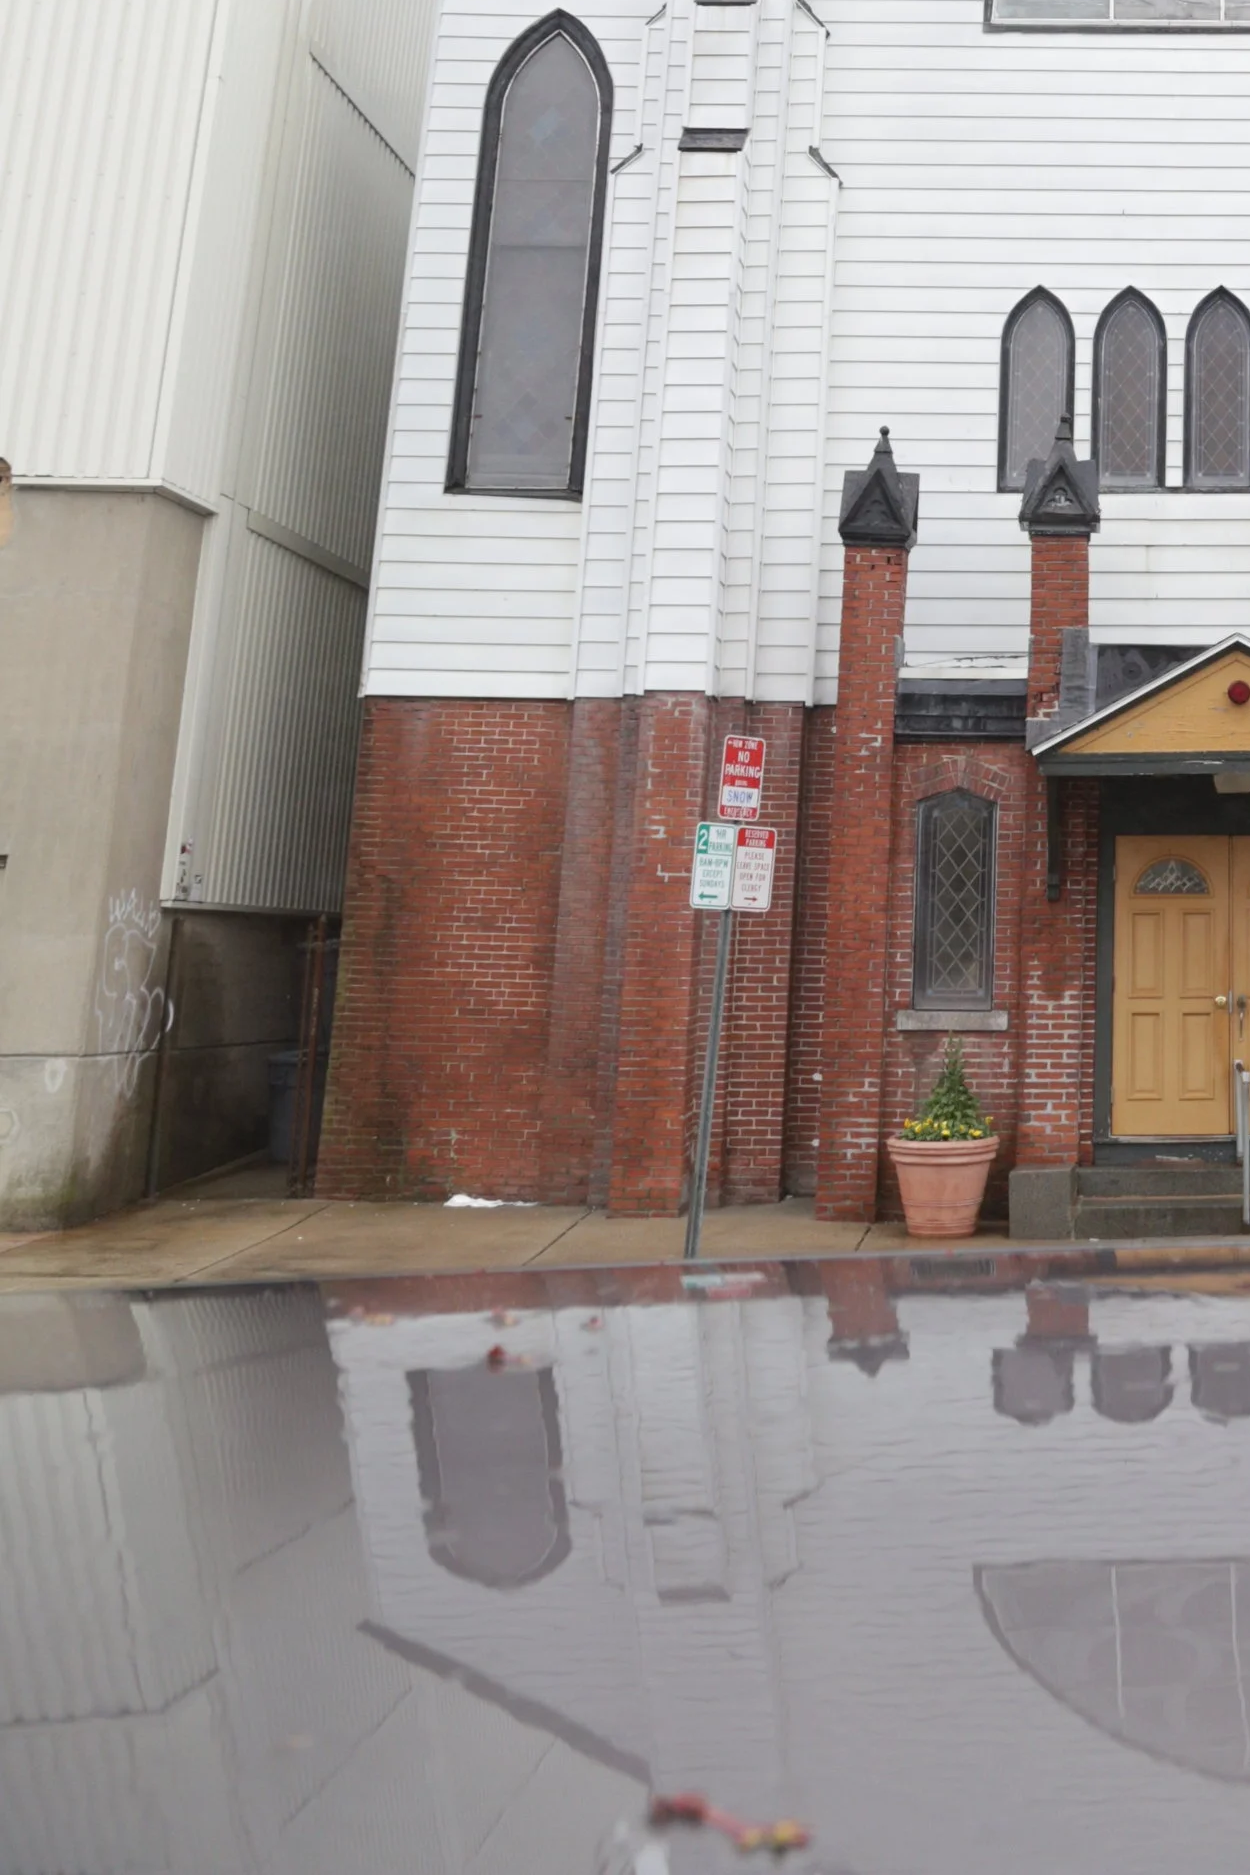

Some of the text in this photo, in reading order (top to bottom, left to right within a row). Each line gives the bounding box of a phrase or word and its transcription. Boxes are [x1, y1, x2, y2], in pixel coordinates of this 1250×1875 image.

[737, 751, 750, 763] NO
[725, 763, 761, 778] PARKING
[726, 789, 754, 804] SNOW
[698, 829, 708, 850] 2
[745, 838, 767, 847] PARKING
[709, 841, 733, 852] PARKING
[744, 851, 765, 861] PLEASE
[739, 872, 766, 882] OPEN FOR
